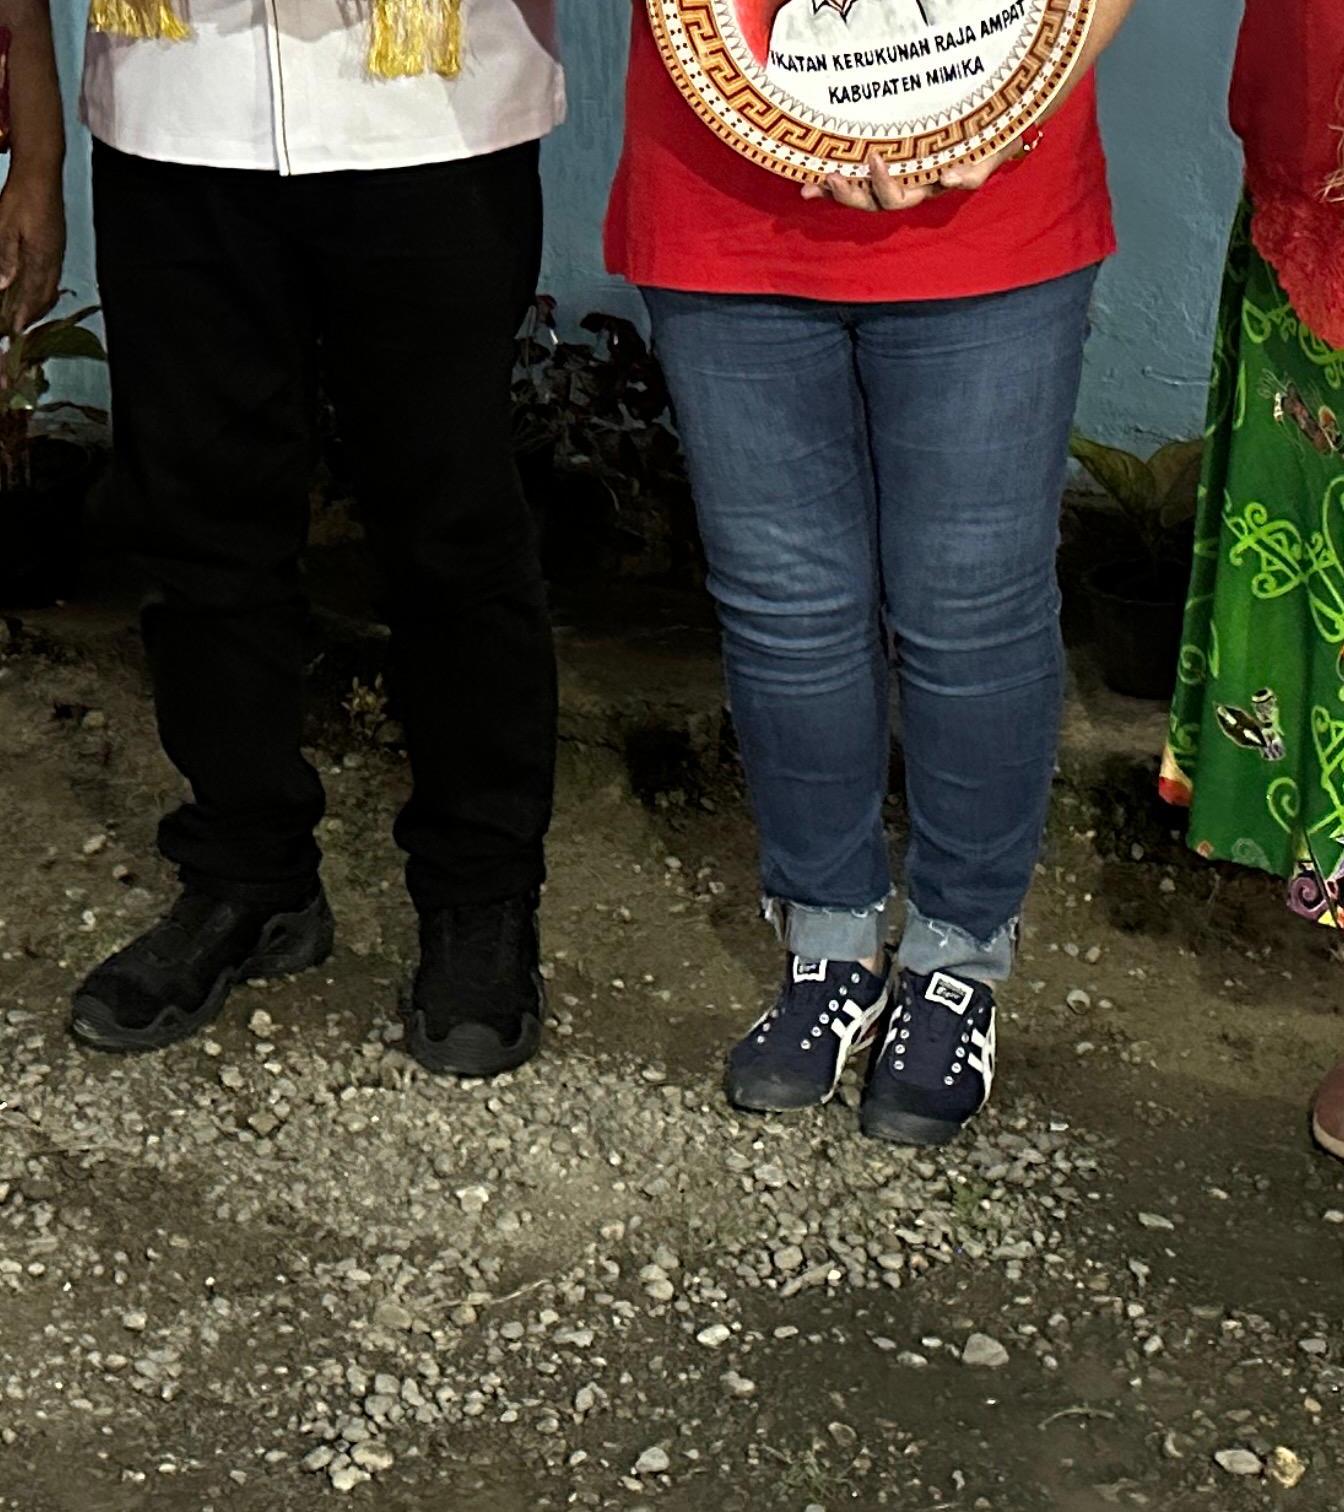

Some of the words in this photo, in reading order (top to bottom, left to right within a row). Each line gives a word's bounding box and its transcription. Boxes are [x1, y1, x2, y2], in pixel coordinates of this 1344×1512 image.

[770, 49, 828, 73] IKATAN
[832, 37, 931, 72] KERUKUNAN
[934, 24, 977, 54] RAJA
[828, 73, 922, 105] KABUPATEN
[925, 55, 985, 87] MIMIKA
